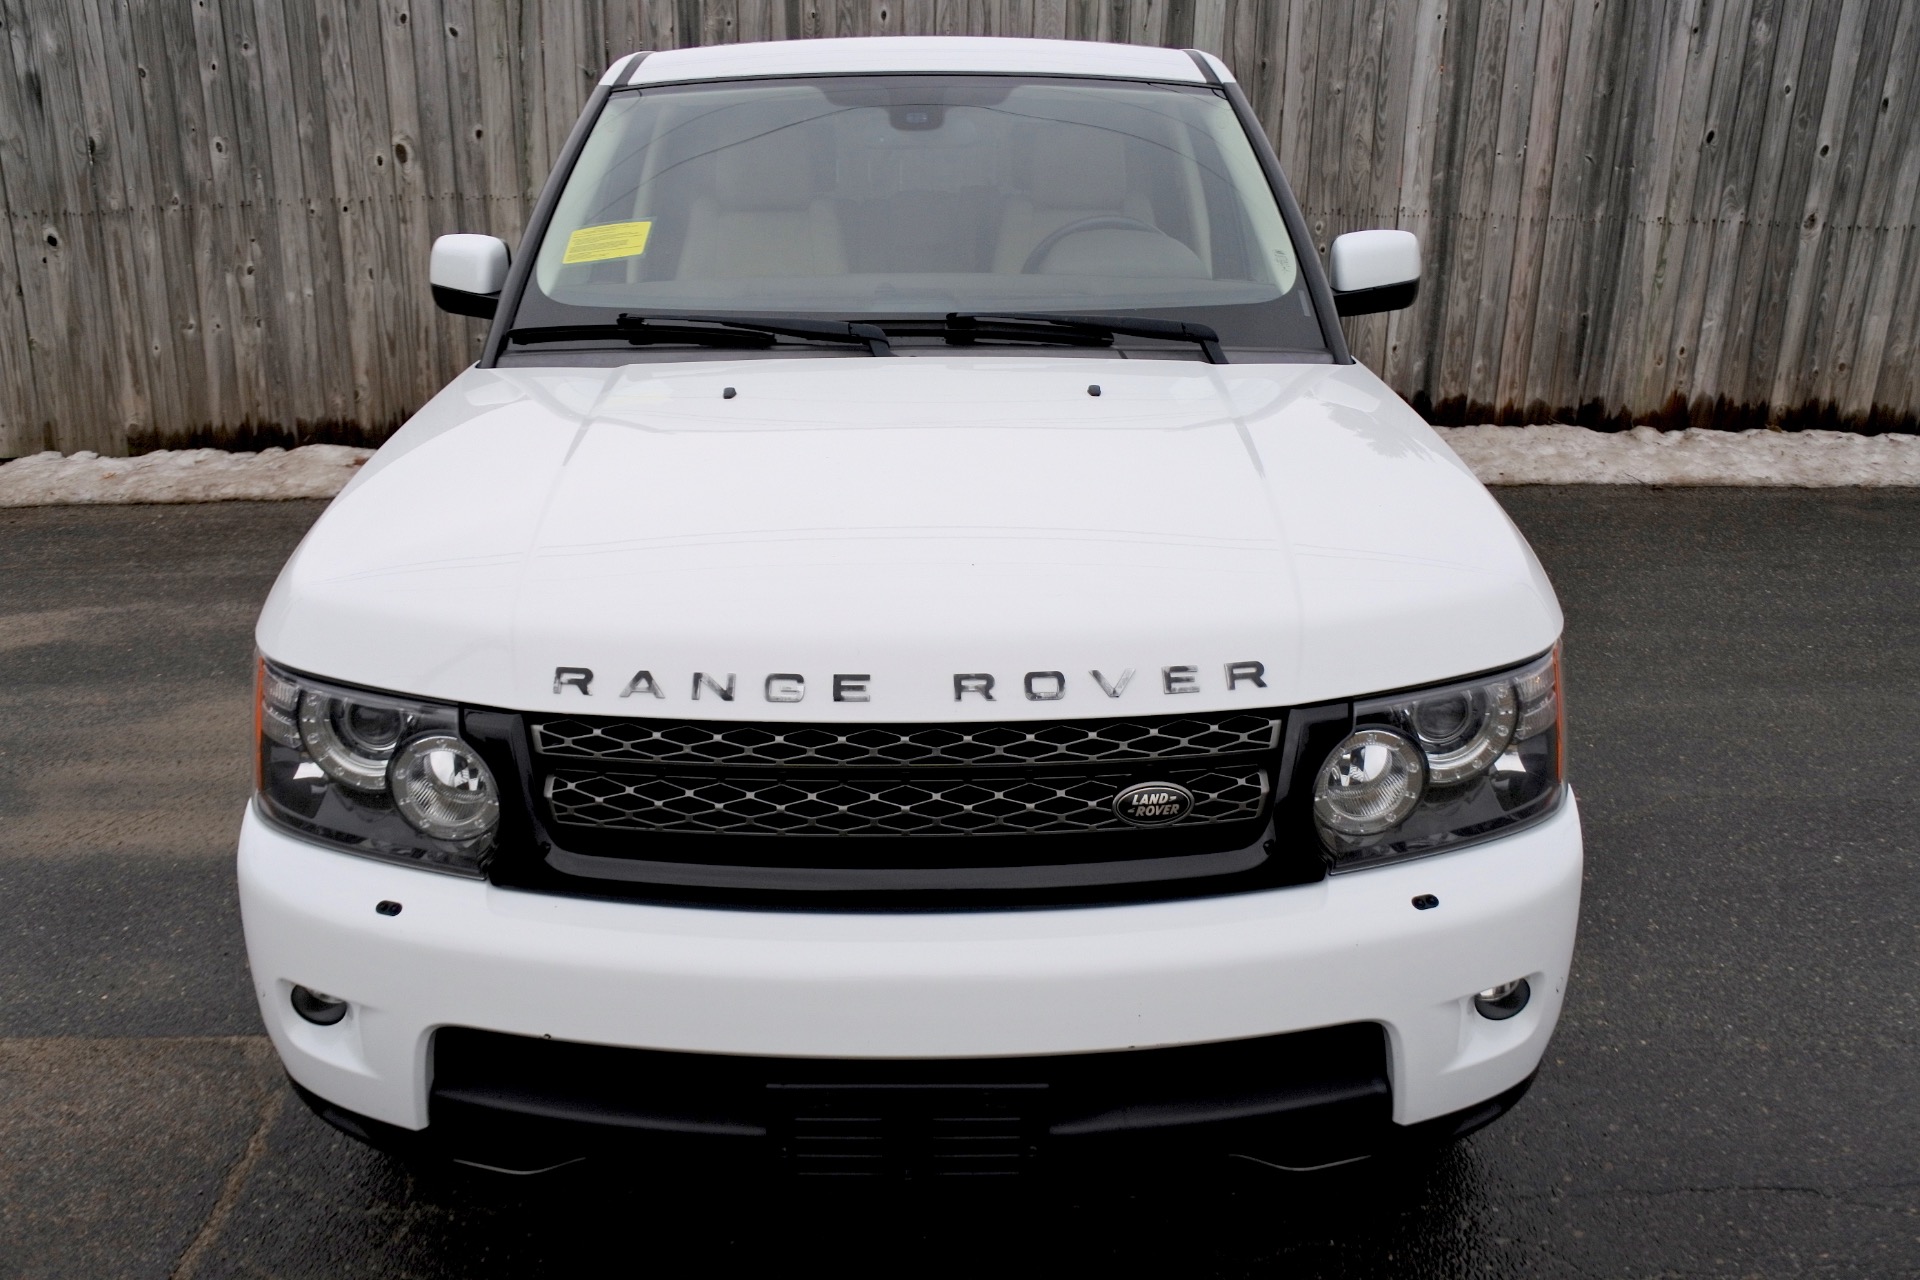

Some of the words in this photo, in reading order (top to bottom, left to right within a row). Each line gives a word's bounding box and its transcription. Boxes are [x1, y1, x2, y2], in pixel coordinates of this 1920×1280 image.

[553, 666, 871, 703] RANGE
[953, 660, 1268, 702] ROVER
[1131, 792, 1169, 806] LAND
[1135, 803, 1180, 817] ROVER
